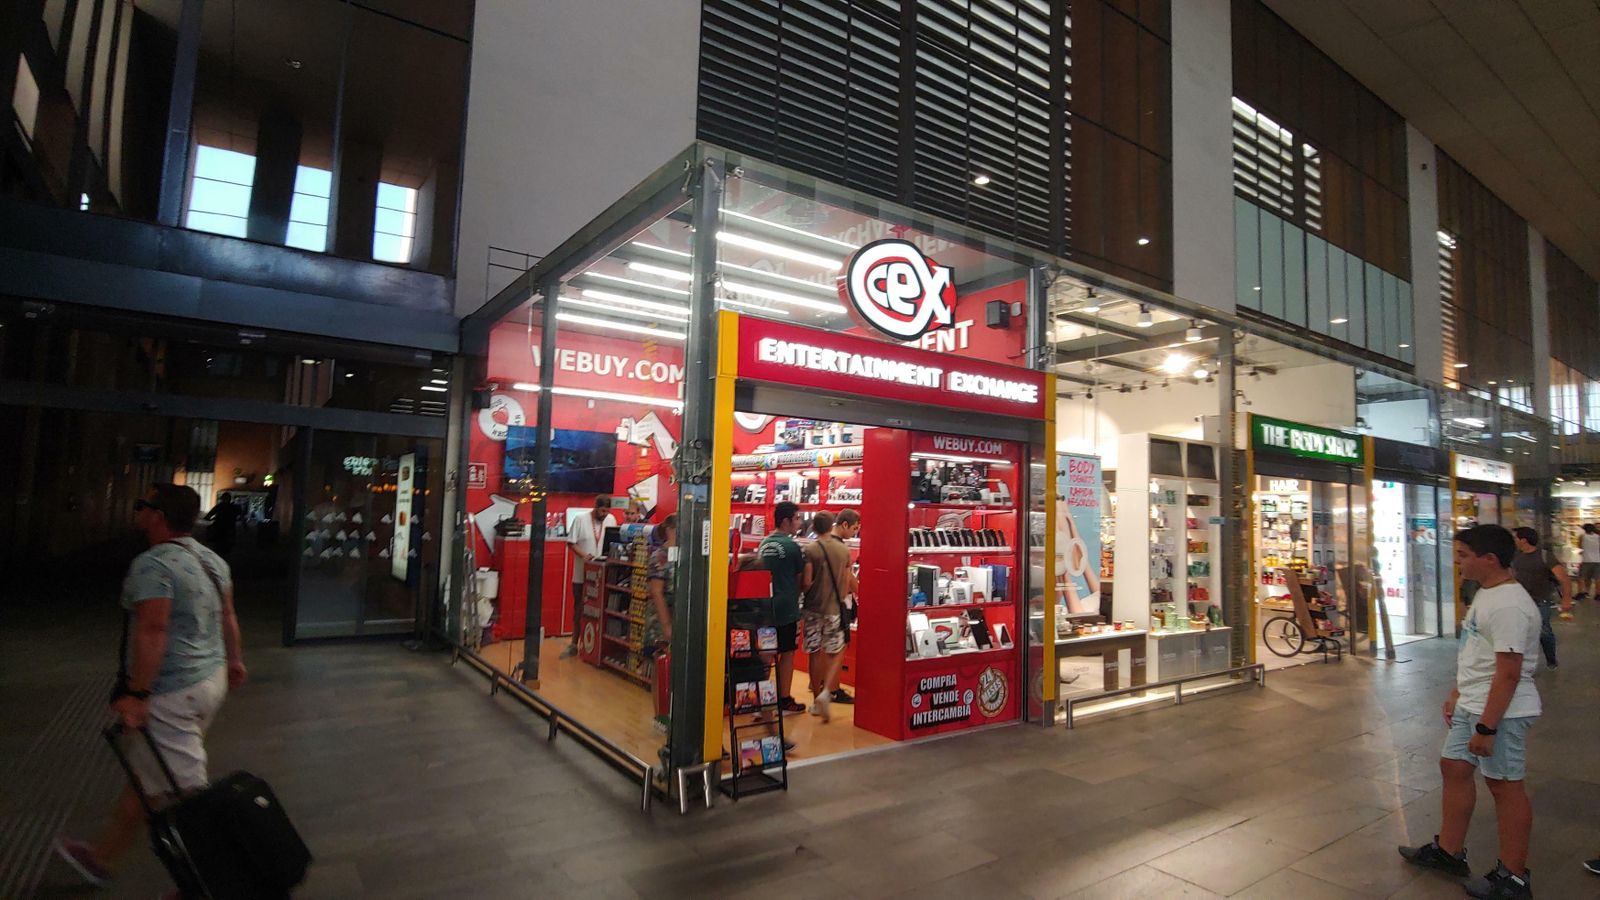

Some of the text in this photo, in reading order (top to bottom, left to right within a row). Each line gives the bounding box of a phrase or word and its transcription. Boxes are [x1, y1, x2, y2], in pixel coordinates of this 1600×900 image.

[757, 337, 1039, 404] ENTERTAINMENT EXCHANGE
[933, 435, 1003, 455] WEBUY.COM
[1260, 423, 1290, 448] THE
[1289, 428, 1324, 454] BODY
[1068, 459, 1096, 474] BODY
[1269, 479, 1300, 492] HAIR
[920, 673, 958, 692] COMPRA
[932, 689, 960, 706] VENDE
[912, 704, 972, 727] INTERCAMBIA
